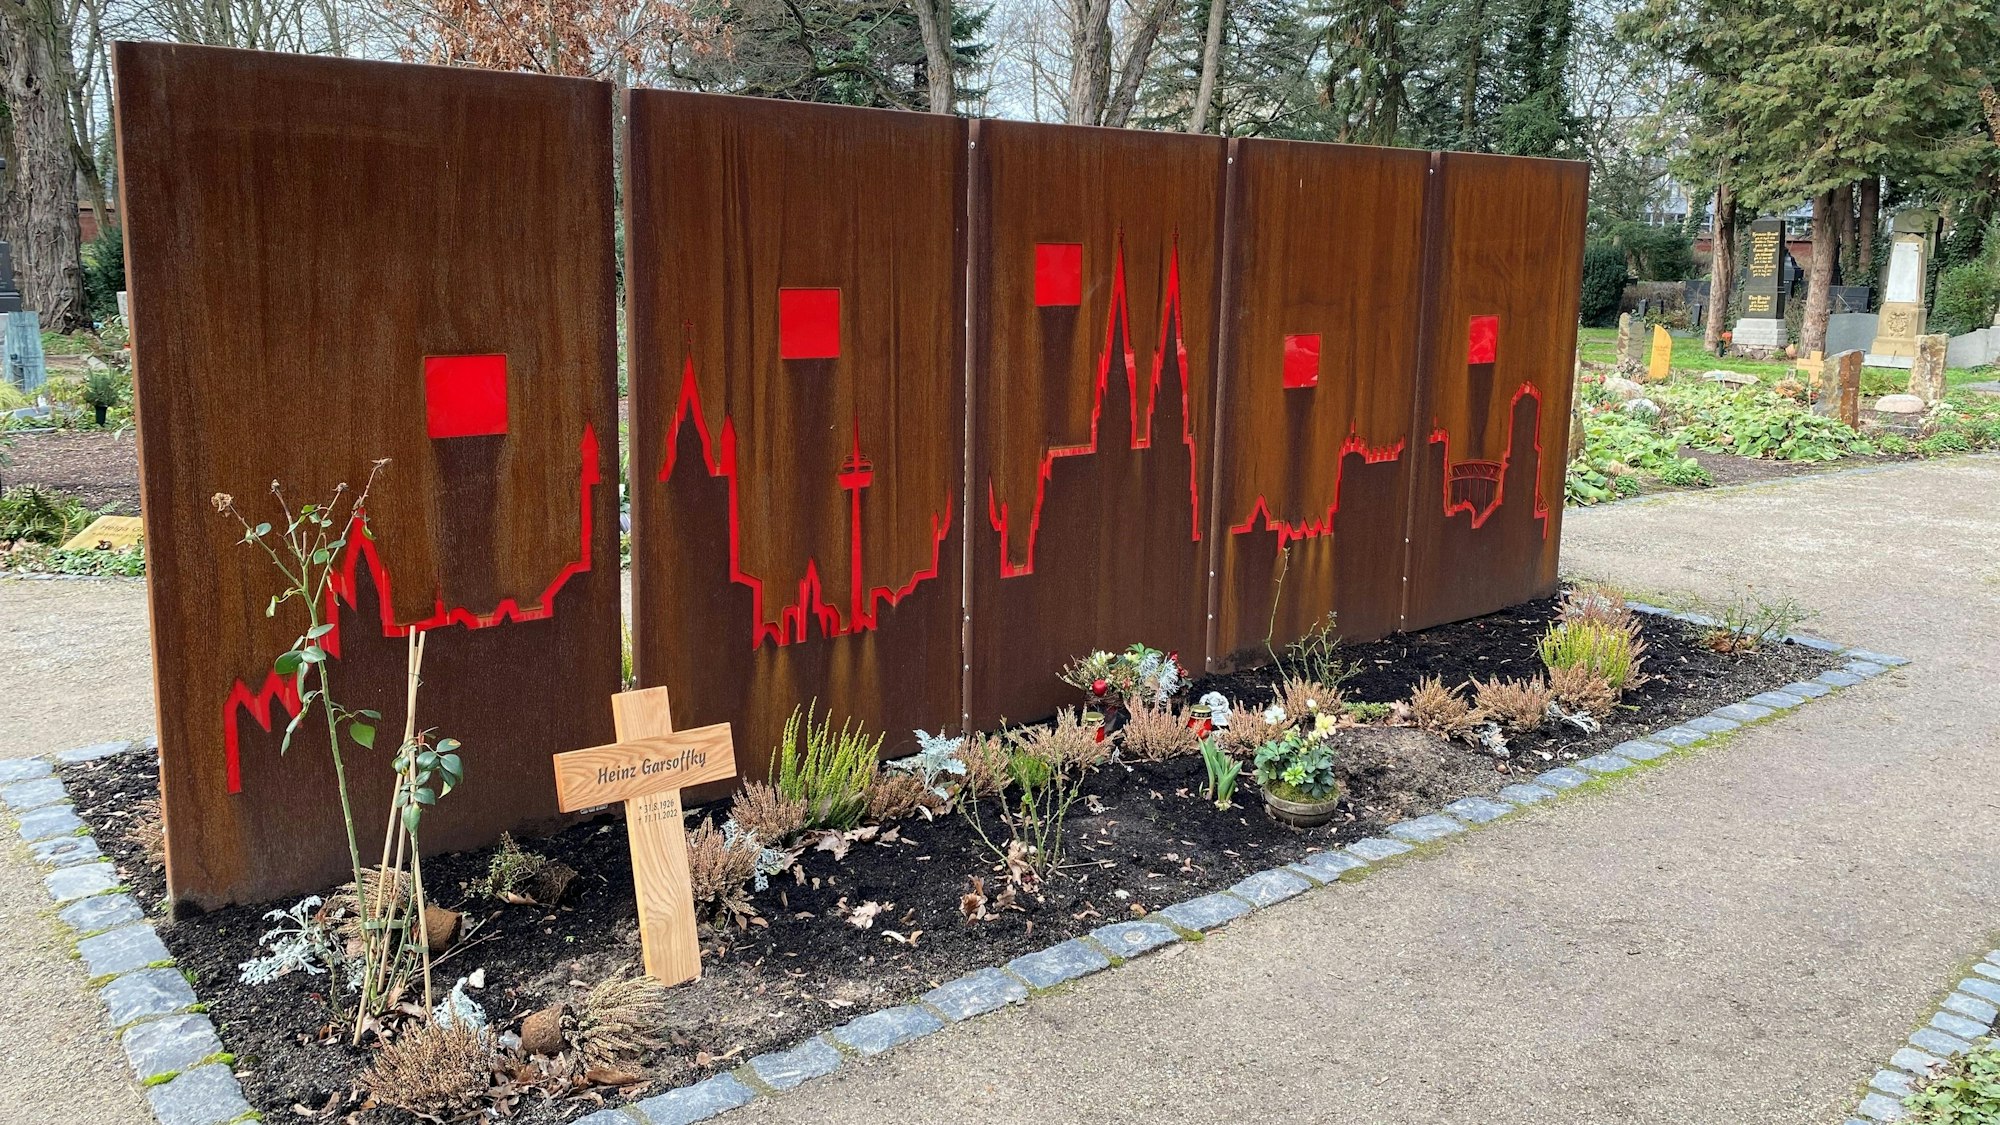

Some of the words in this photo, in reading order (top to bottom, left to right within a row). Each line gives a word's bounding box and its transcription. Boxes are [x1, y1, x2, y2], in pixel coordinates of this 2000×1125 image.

[597, 765, 636, 784] Heinz
[642, 748, 706, 775] Garsoffky
[644, 799, 674, 813] 31.8.1926
[644, 808, 678, 823] 11.11.2022
